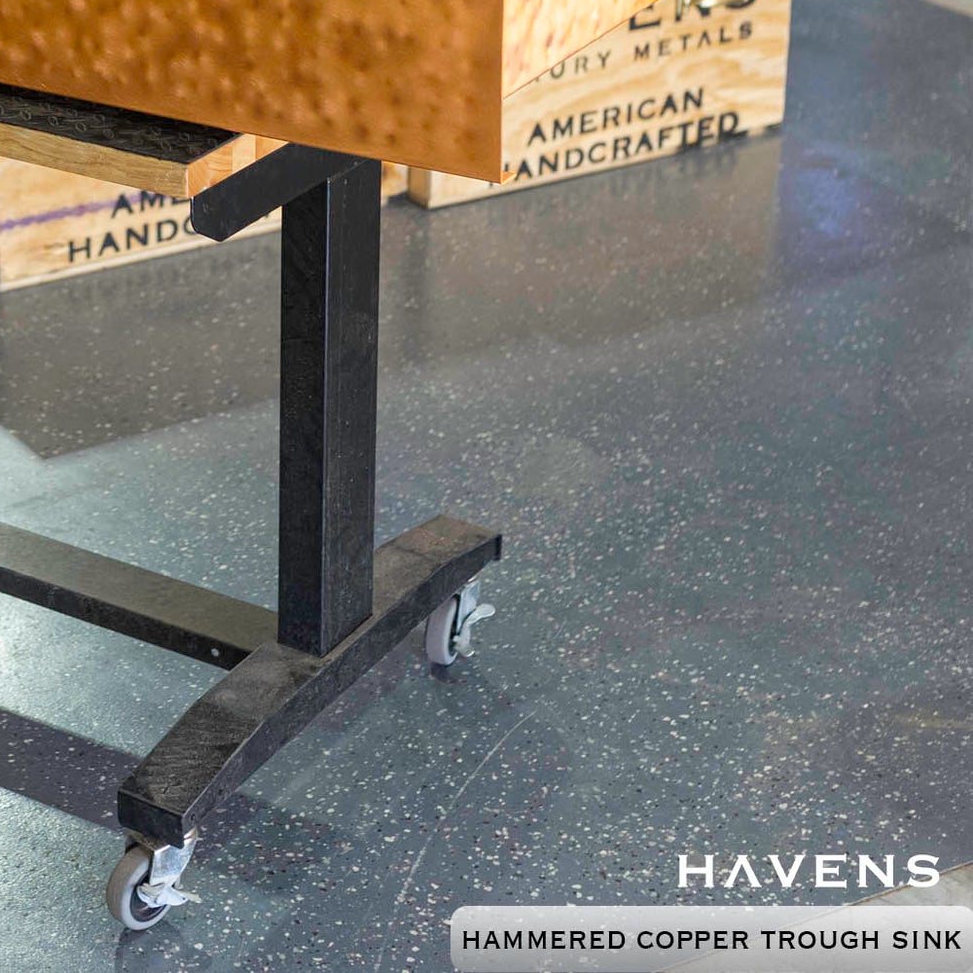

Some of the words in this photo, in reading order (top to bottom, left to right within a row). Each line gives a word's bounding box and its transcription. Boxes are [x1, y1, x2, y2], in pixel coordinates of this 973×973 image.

[535, 49, 611, 83] URY
[634, 21, 752, 61] METALS
[527, 87, 704, 146] AMERICAN
[488, 111, 740, 187] ANDCRAFTED
